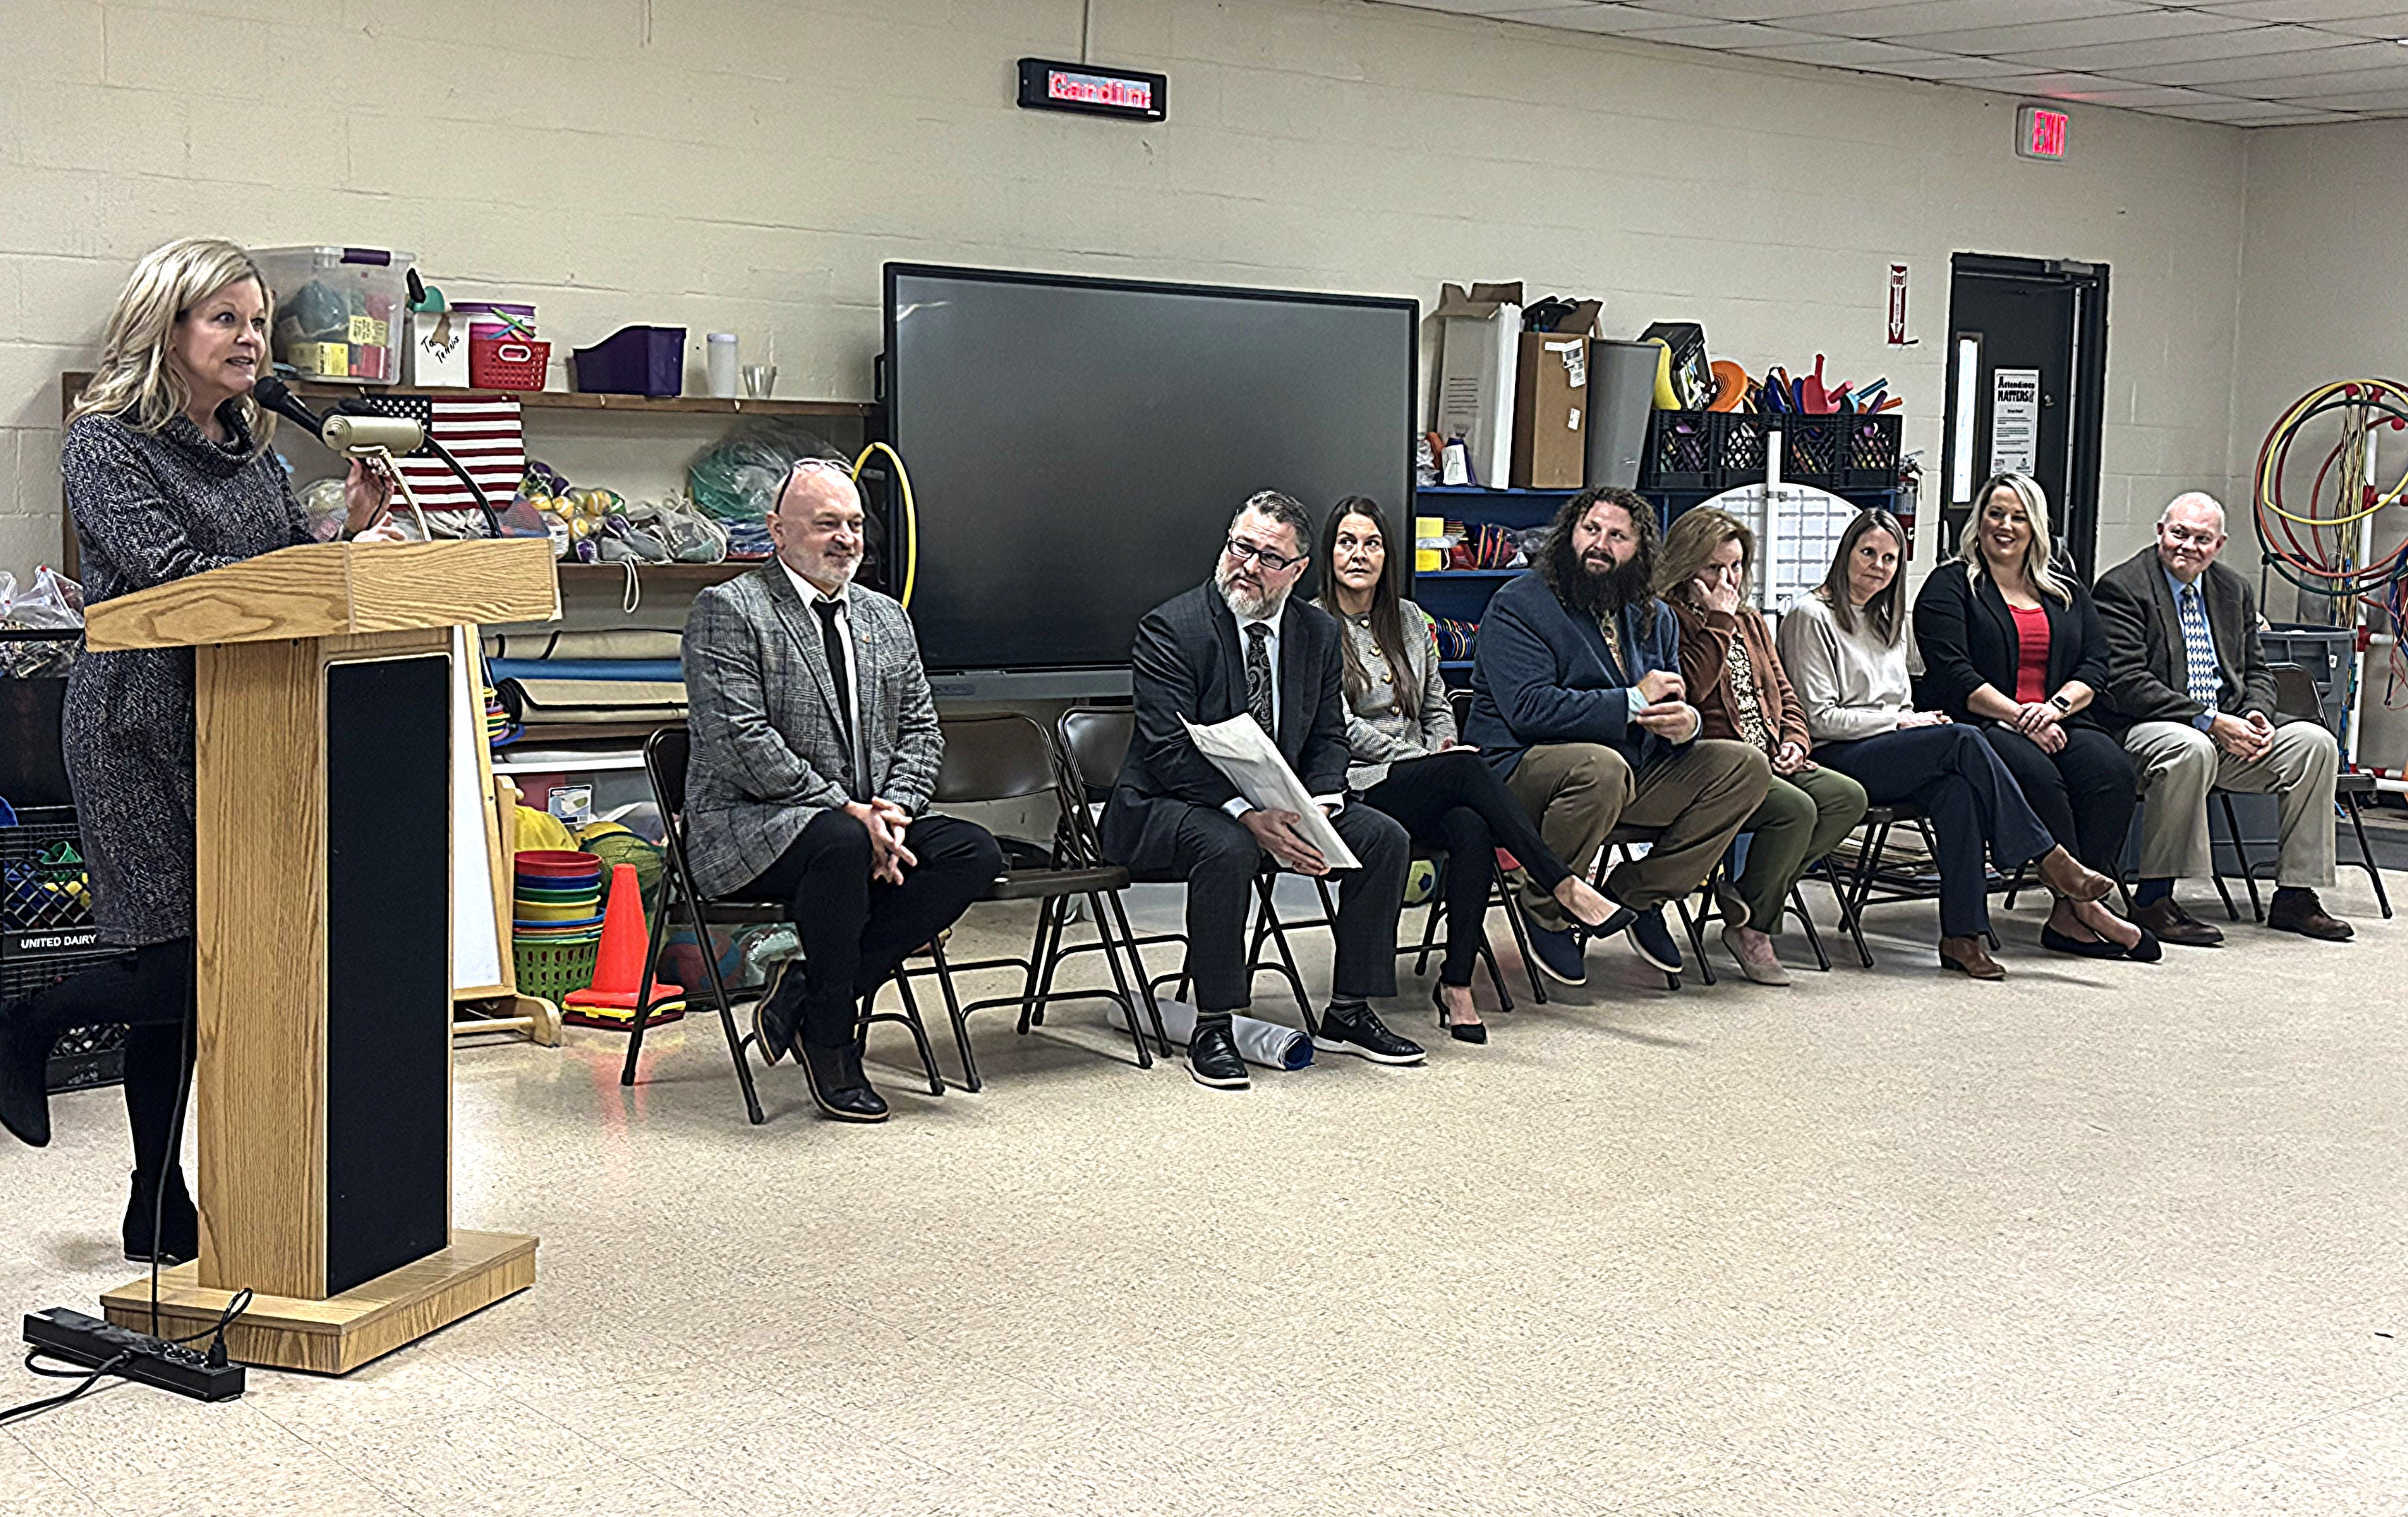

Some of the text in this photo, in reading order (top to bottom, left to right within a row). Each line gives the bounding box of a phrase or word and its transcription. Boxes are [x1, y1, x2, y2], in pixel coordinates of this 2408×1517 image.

[2032, 110, 2069, 157] EXIT
[1893, 275, 1904, 285] FIRE
[21, 934, 97, 949] UNITED DAIRY
